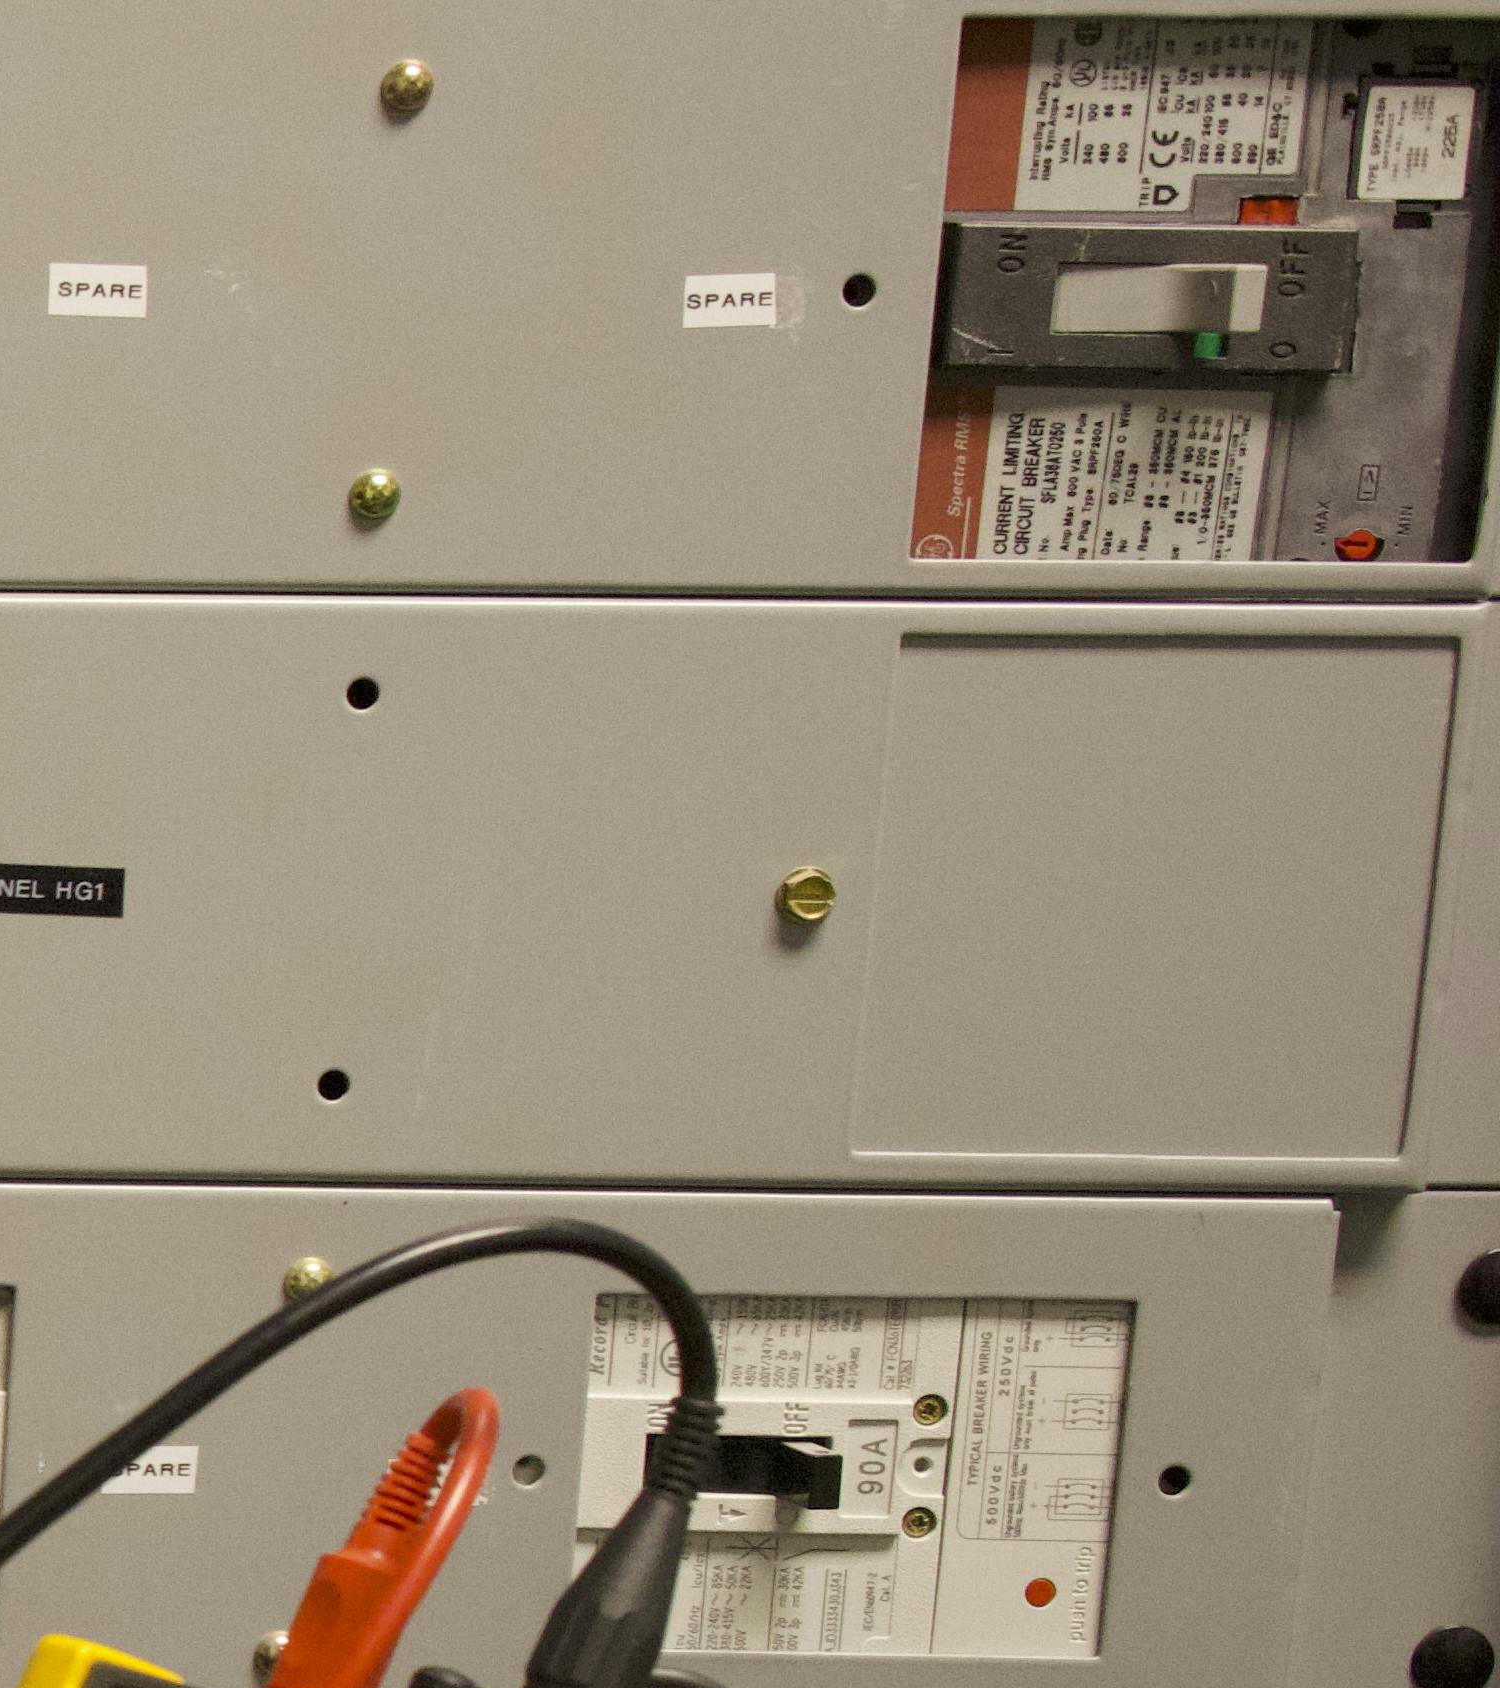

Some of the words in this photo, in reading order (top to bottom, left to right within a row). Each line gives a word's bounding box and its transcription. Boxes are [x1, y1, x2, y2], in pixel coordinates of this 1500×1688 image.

[1035, 81, 1051, 115] Rating
[1029, 121, 1046, 180] Interrupting
[1442, 114, 1460, 158] 225A
[1139, 177, 1151, 207] TRIP
[1366, 164, 1379, 192] TYPE
[997, 231, 1028, 273] ON
[1276, 237, 1311, 298] OFF
[58, 281, 142, 299] SPARE
[687, 292, 773, 310] SPARE
[1002, 413, 1025, 475] LIMITING
[1021, 418, 1046, 488] BREAKER
[1071, 450, 1082, 472] VAC
[946, 456, 966, 517] Spectra
[993, 485, 1015, 555] CURRENT
[1013, 497, 1035, 555] CIRCUIT
[1062, 505, 1075, 526] Max
[1077, 520, 1092, 541] Plug
[1313, 500, 1331, 534] MAX
[1396, 505, 1414, 537] MIN
[1060, 529, 1074, 551] Amp
[56, 880, 104, 901] HG1
[977, 1331, 993, 1375] WIRING
[784, 1402, 809, 1435] OFF
[971, 1381, 987, 1435] BREAKER
[121, 1463, 192, 1477] PARE
[857, 1436, 890, 1497] 90A
[966, 1440, 982, 1486] TYPICAL
[1073, 1546, 1092, 1577] trip
[1071, 1579, 1087, 1597] to
[1066, 1600, 1089, 1643] push
